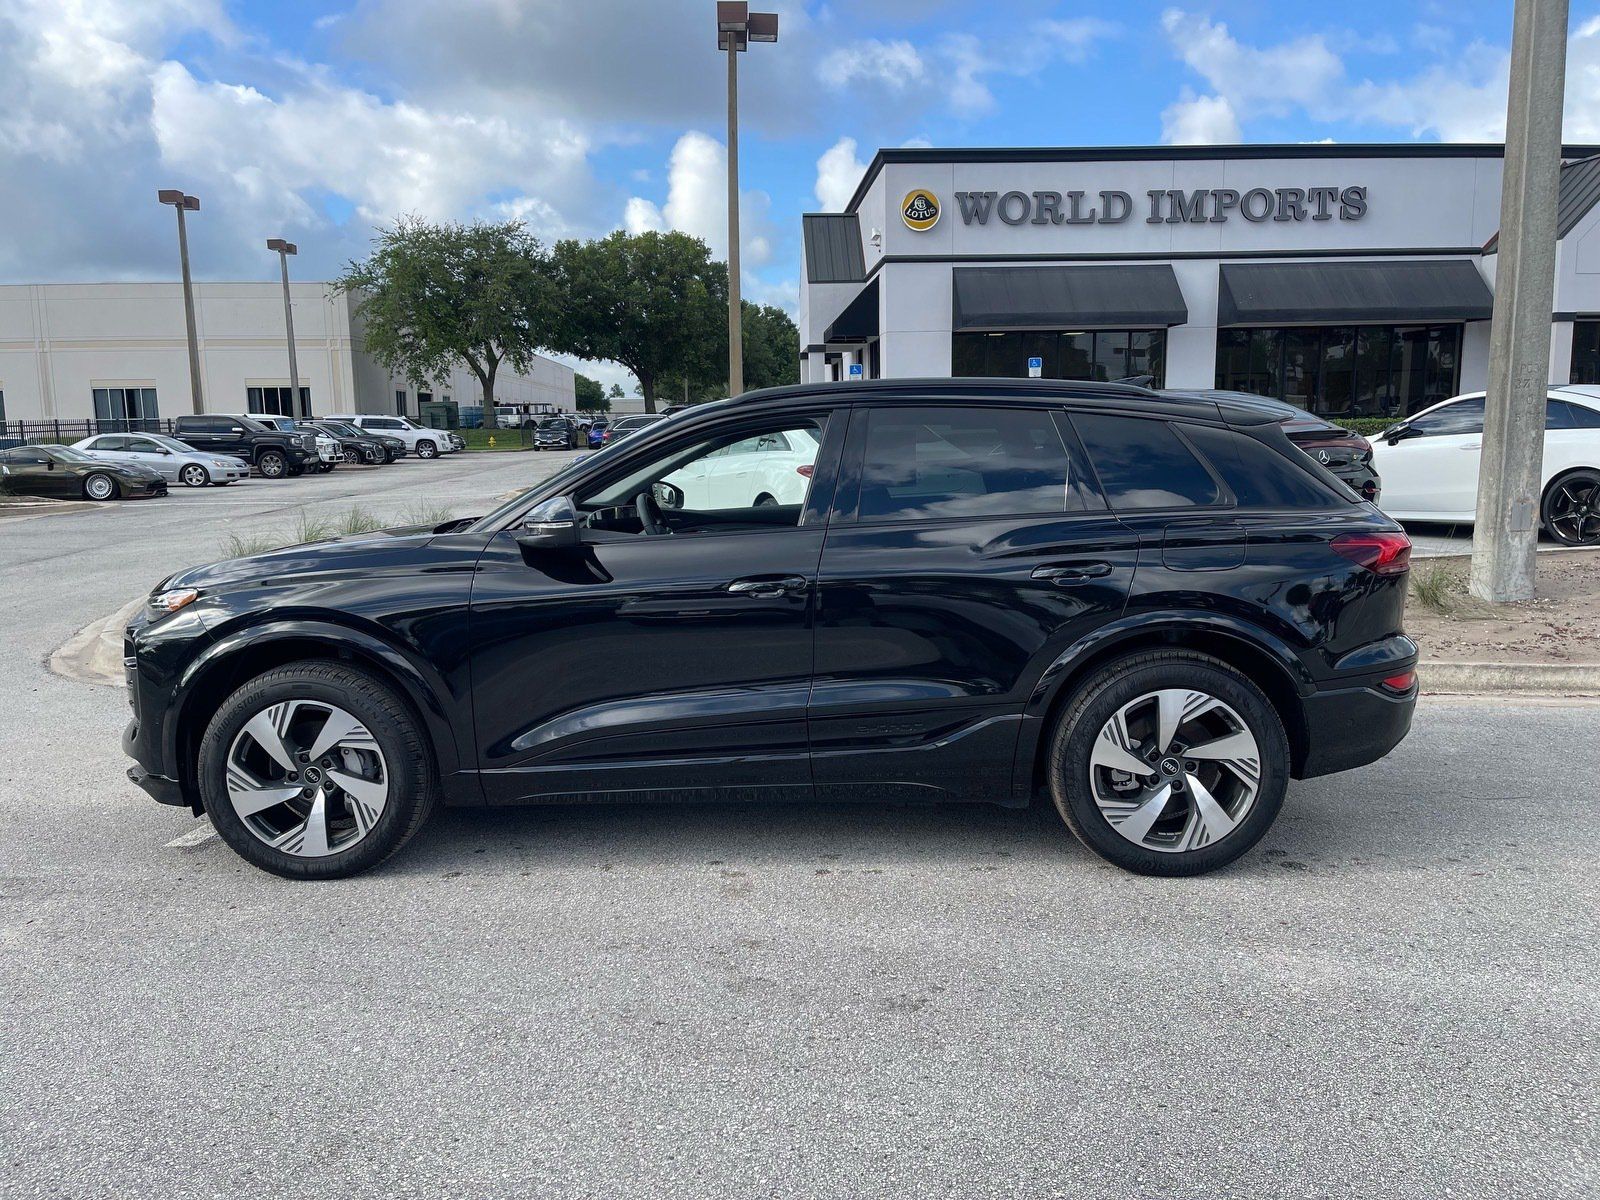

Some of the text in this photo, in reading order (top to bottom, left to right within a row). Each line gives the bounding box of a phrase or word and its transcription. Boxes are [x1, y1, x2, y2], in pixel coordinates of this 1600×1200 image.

[906, 206, 936, 219] LOTUS
[954, 186, 1368, 226] WORLD IMPORTS
